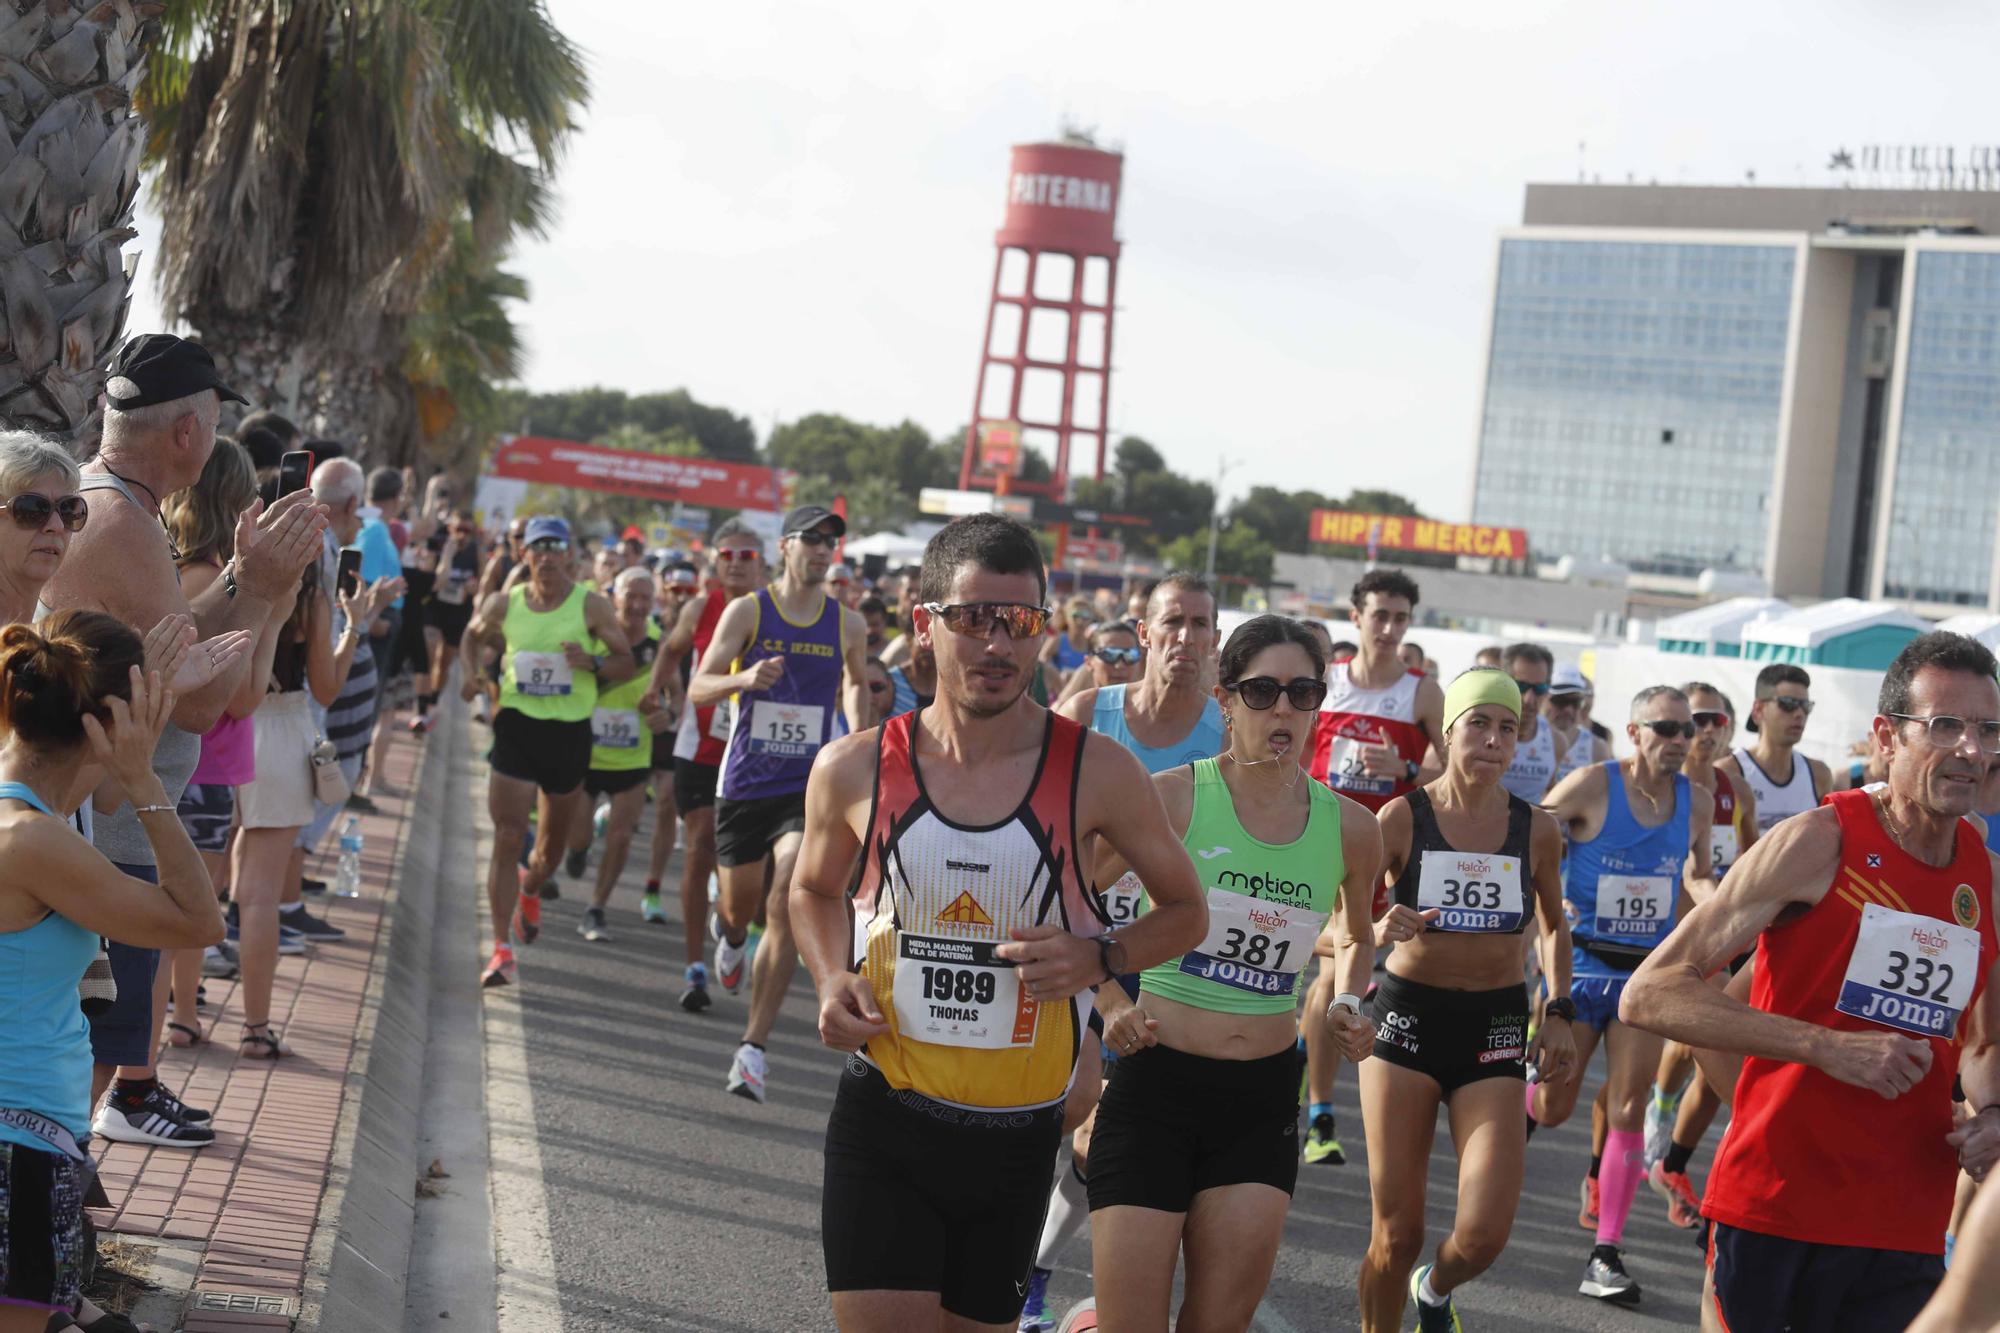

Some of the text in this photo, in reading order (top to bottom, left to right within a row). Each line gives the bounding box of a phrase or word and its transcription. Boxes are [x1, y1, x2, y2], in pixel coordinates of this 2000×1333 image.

[1319, 512, 1513, 557] HIPER MERCA
[531, 668, 554, 684] 87
[768, 722, 807, 742] 155
[1218, 871, 1312, 898] motion
[1442, 879, 1501, 909] 363
[1616, 898, 1657, 918] 195
[947, 922, 994, 933] CATALUNYA
[1434, 910, 1501, 928] Joma
[1608, 920, 1656, 934] Joma
[909, 940, 973, 953] MEDIA MARATÓN
[909, 948, 925, 956] VILA
[939, 951, 974, 961] PATERNA
[1217, 928, 1291, 970] 381
[922, 966, 996, 1004] 1989
[1201, 959, 1281, 992] Joma
[1880, 951, 1953, 1003] 332
[929, 1005, 979, 1021] THOMAS
[1862, 992, 1946, 1030] Joma
[1490, 1025, 1521, 1034] running
[1487, 1034, 1521, 1048] TEAM
[964, 1112, 1033, 1128] PRO
